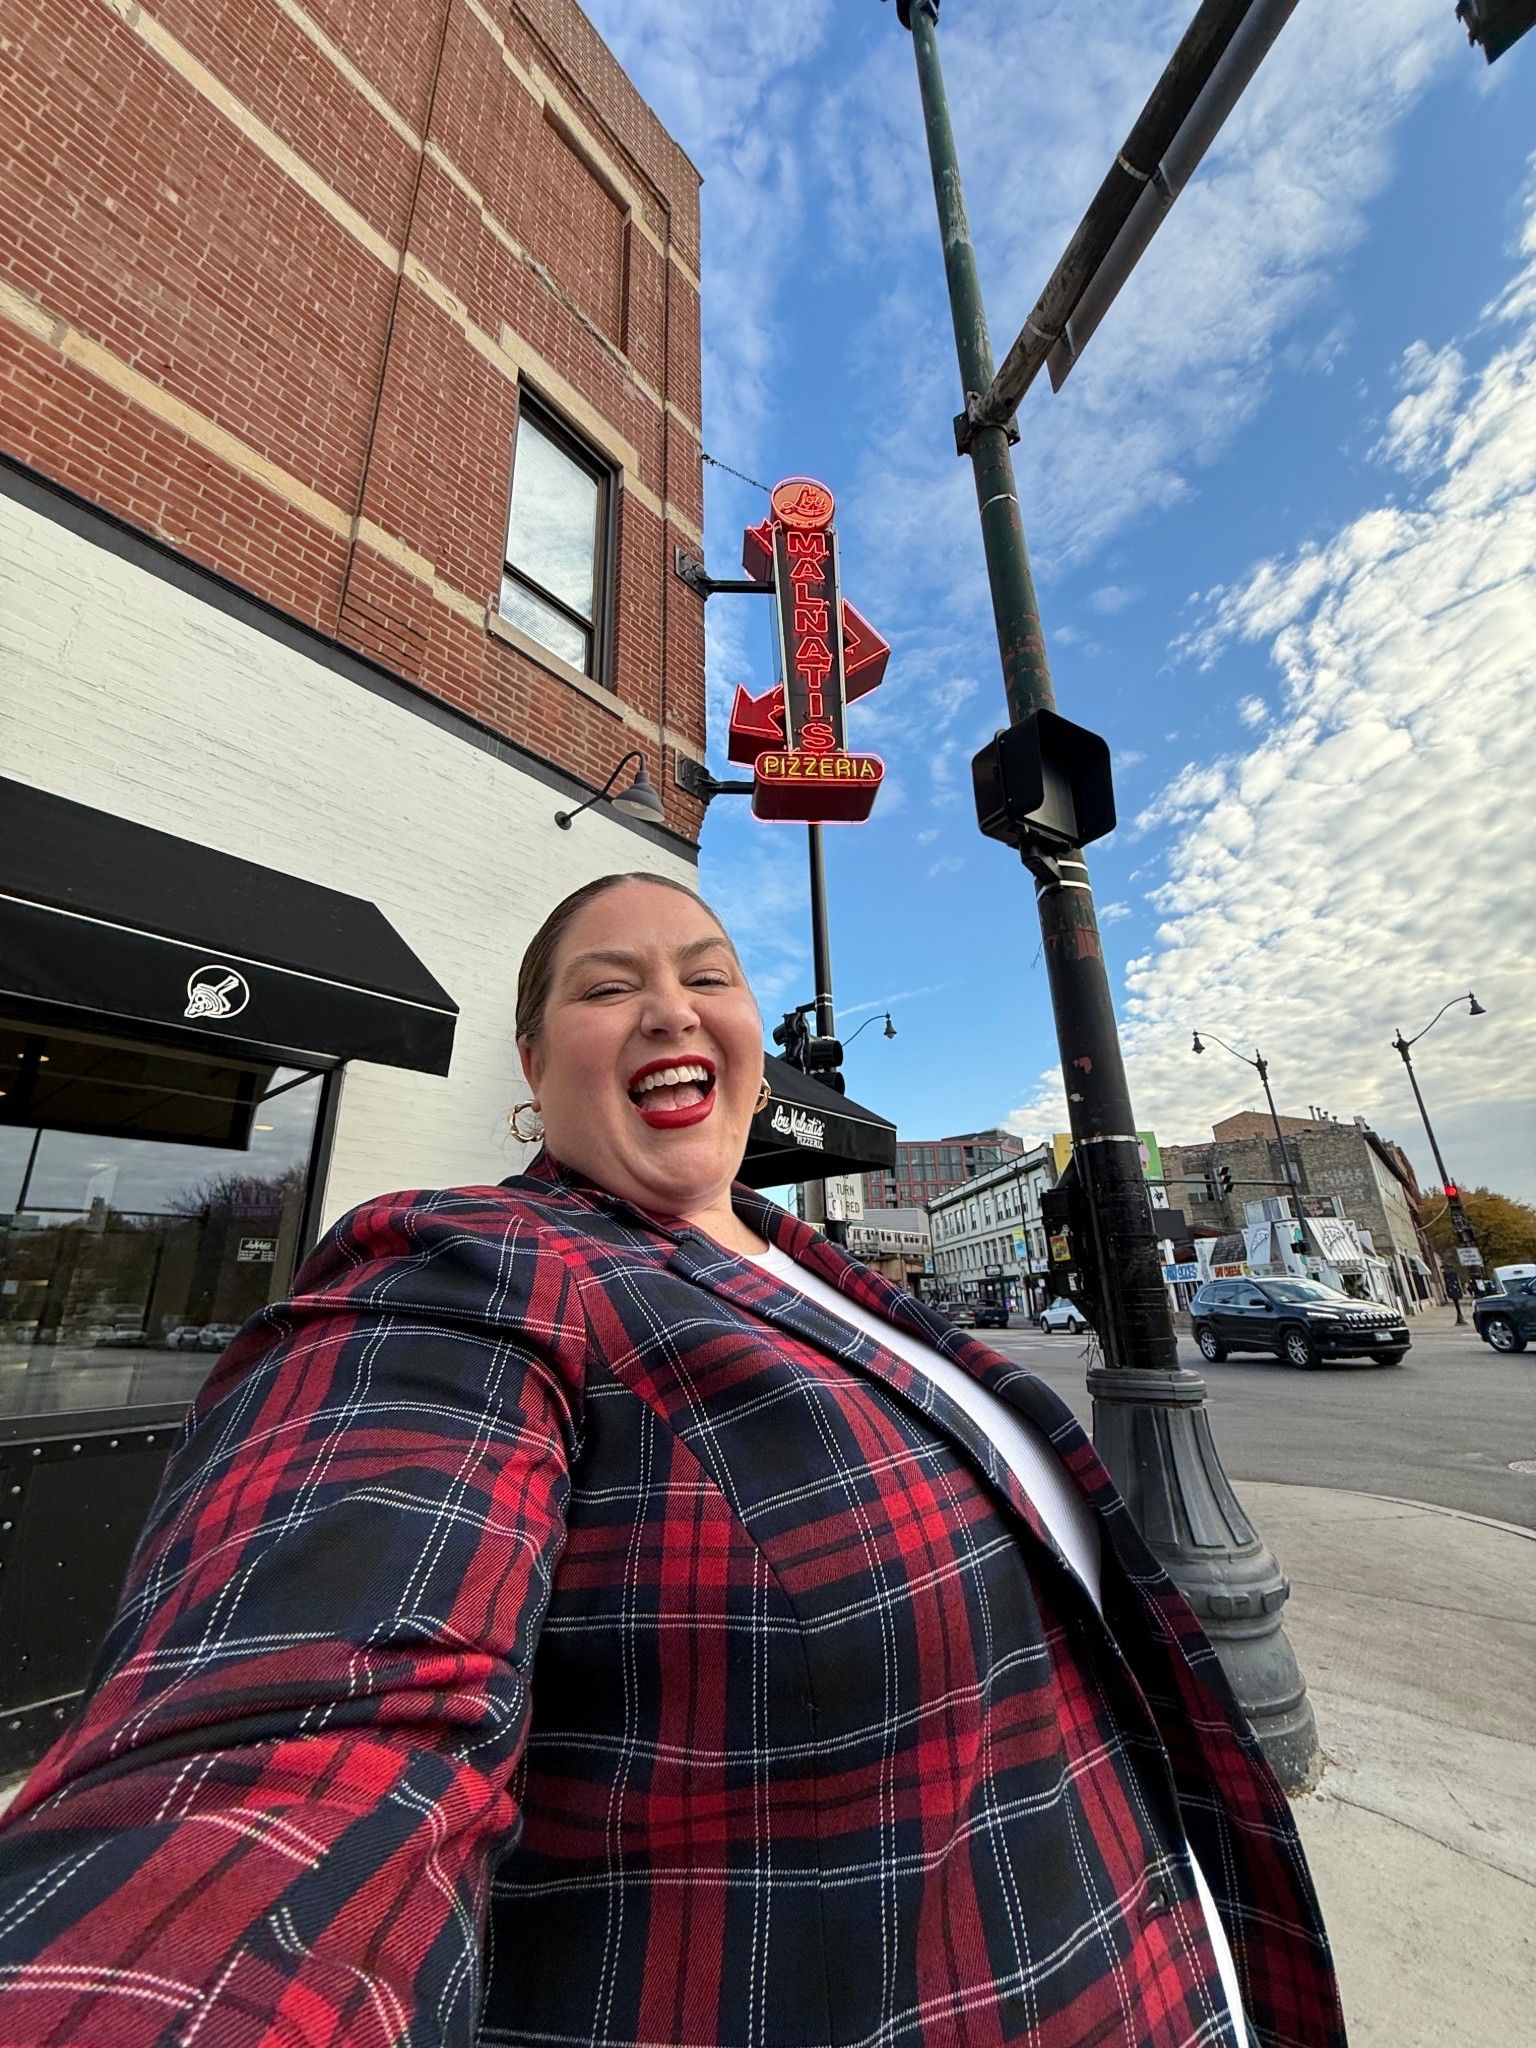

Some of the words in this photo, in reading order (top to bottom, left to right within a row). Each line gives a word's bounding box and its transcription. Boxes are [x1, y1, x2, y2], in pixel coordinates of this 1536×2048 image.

[782, 484, 827, 512] Lou
[764, 756, 876, 777] PIZZERIA
[771, 1104, 791, 1135] Lou
[797, 1137, 824, 1150] PIZZERIA
[836, 1183, 855, 1196] TURN
[846, 1201, 860, 1213] RED
